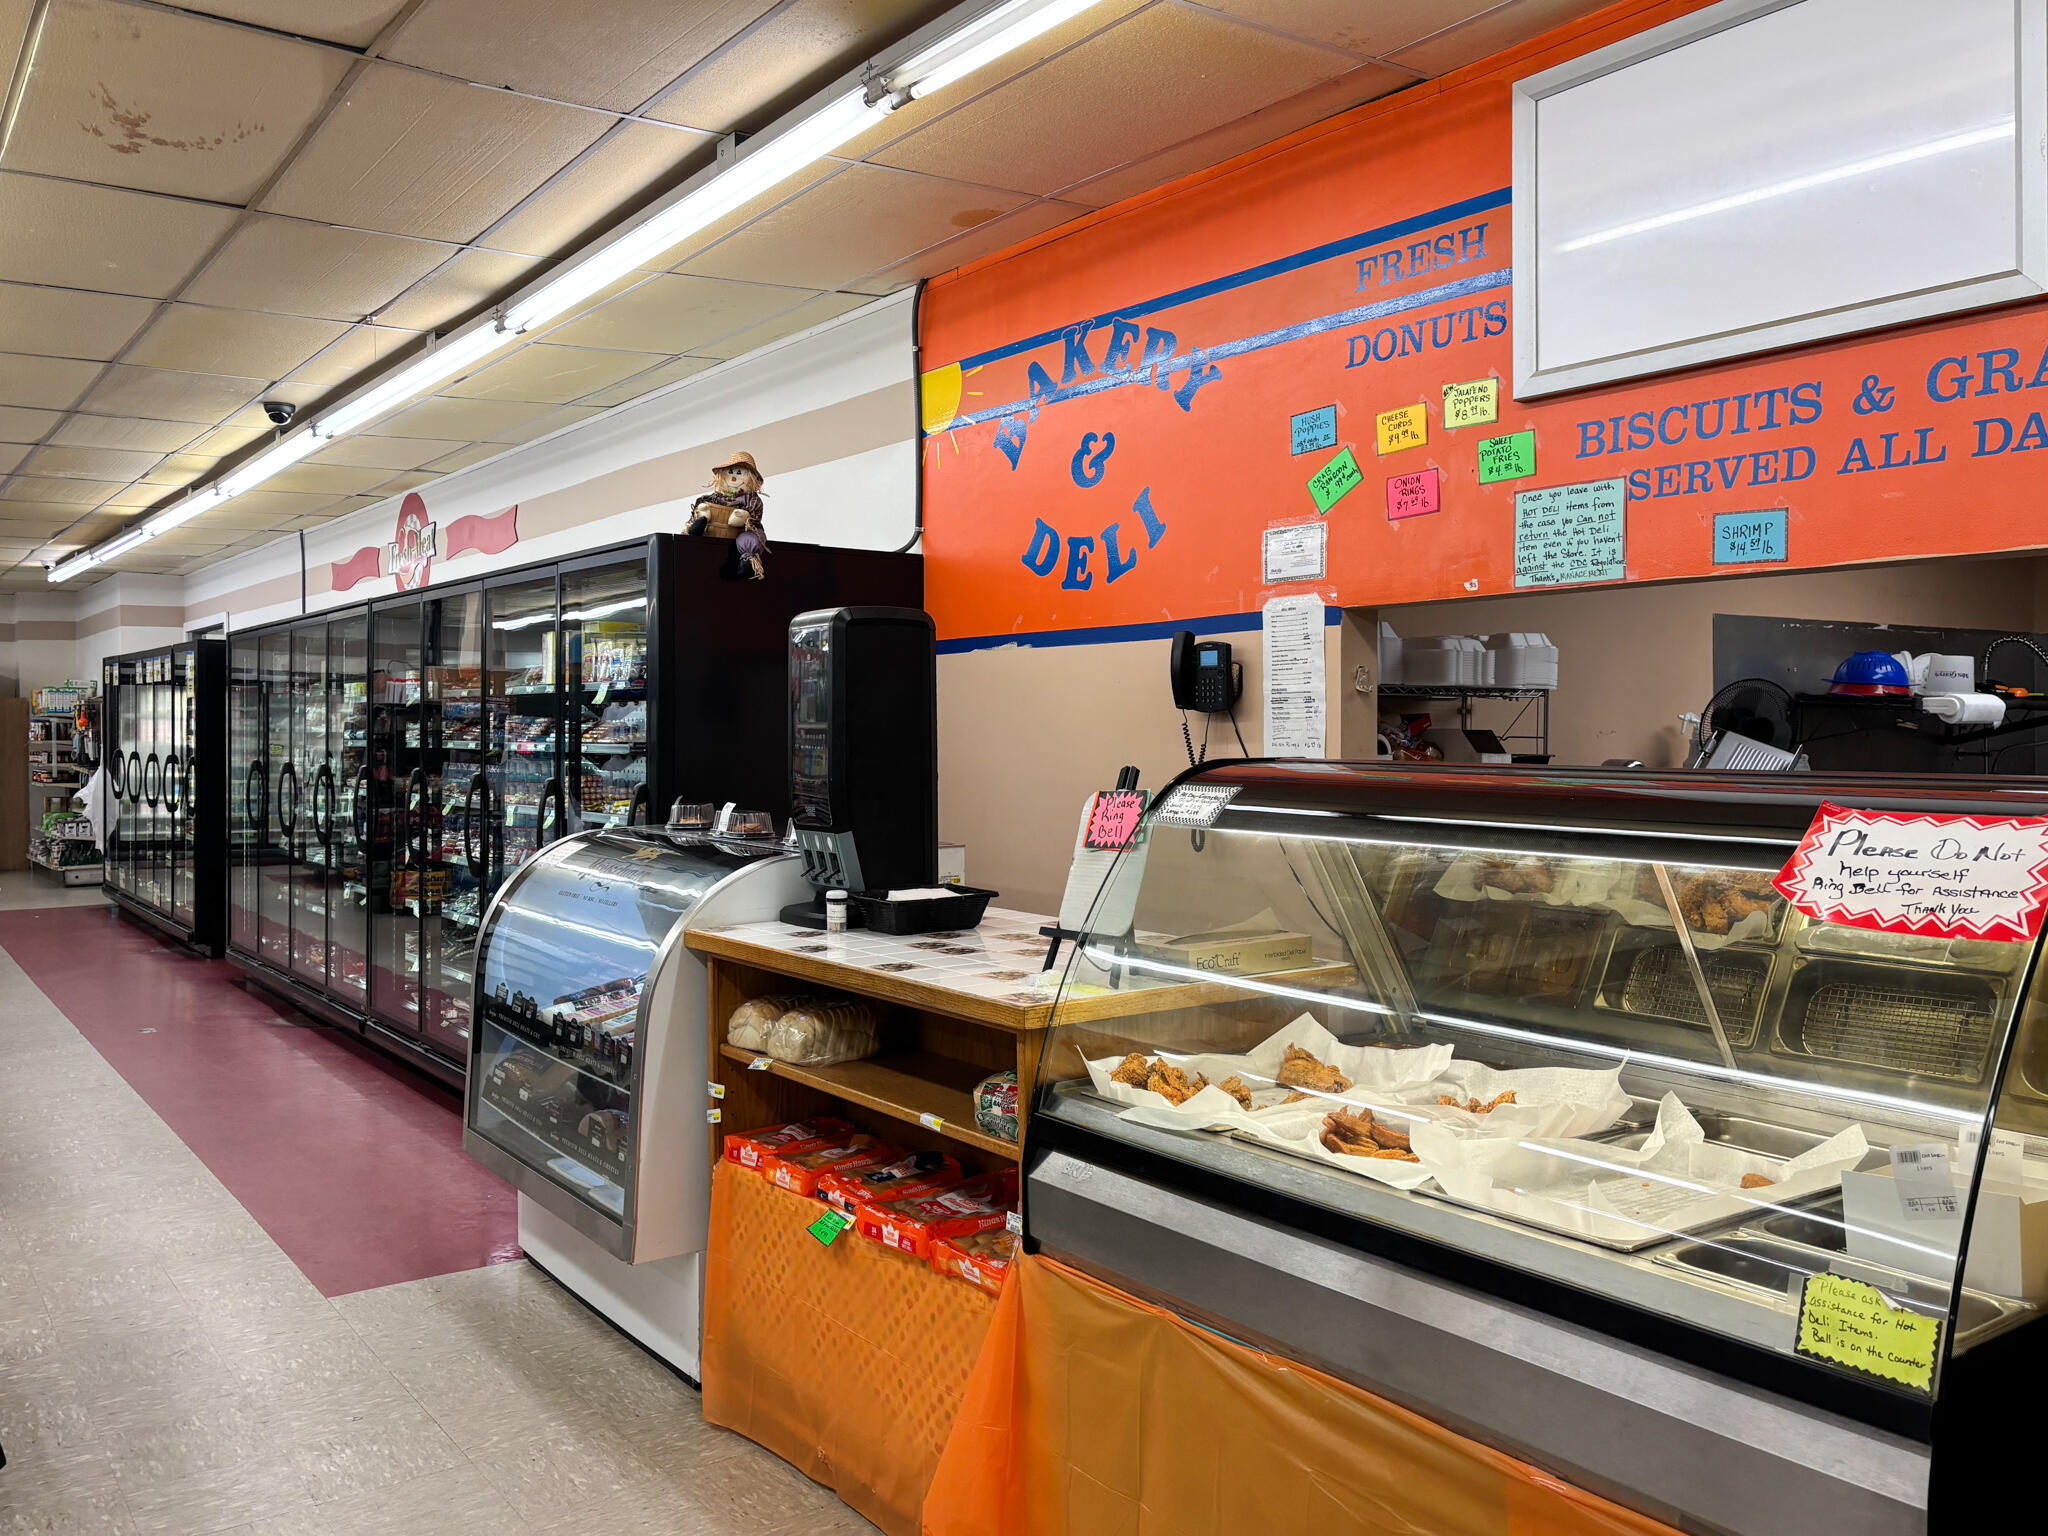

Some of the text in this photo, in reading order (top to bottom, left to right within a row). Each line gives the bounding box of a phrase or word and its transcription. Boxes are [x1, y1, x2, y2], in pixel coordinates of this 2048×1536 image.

[1355, 223, 1488, 292] FRESH
[1345, 300, 1507, 369] DONUTS
[994, 318, 1222, 471] BAKERY
[1453, 394, 1491, 409] POPPERS
[1301, 413, 1321, 427] HUSH
[1381, 410, 1408, 426] CHEESE
[1388, 419, 1412, 432] CURDS
[1576, 382, 1823, 459] BISCUITS
[1853, 375, 1895, 415] &
[1489, 436, 1513, 449] SWEET
[1071, 431, 1115, 488] &
[1480, 445, 1512, 462] POTATO
[1493, 451, 1521, 464] FRIES
[1628, 446, 1816, 501] SERVED
[1838, 428, 1946, 474] ALL
[1313, 467, 1331, 488] CRAB
[1394, 475, 1421, 489] ONION
[1399, 485, 1426, 497] RINGS
[1522, 494, 1542, 504] Once
[1549, 491, 1561, 503] you
[1567, 487, 1588, 496] leave
[1522, 497, 1614, 517] HOT DELI items from
[1519, 521, 1533, 529] the
[1537, 519, 1556, 527] case
[1562, 518, 1573, 529] you
[1598, 510, 1616, 521] not
[1021, 487, 1167, 591] DELI
[1519, 525, 1609, 540] return the Hot Deli
[1722, 522, 1774, 540] SHRIMP
[1519, 542, 1537, 552] item
[1543, 541, 1561, 549] even
[1567, 537, 1573, 547] if
[1577, 539, 1589, 552] you
[1518, 553, 1536, 565] left
[1543, 551, 1557, 560] the
[1592, 547, 1602, 557] It
[1609, 547, 1616, 556] is
[1516, 562, 1546, 575] against
[1552, 560, 1565, 568] the
[1570, 559, 1587, 568] CDC
[1106, 797, 1135, 809] Please
[1101, 808, 1124, 823] Ring
[1098, 825, 1123, 838] Bell
[1930, 838, 1967, 860] Do
[1972, 842, 2026, 861] Not
[1840, 861, 1969, 885] help yourself
[1848, 883, 1891, 895] Bell
[1895, 883, 1924, 895] for
[1946, 904, 1980, 928] You
[1816, 1277, 1856, 1300] Please
[1862, 1295, 1881, 1307] ask
[1809, 1296, 1917, 1332] assistance for Hot
[1808, 1310, 1878, 1339] Deli Items.
[1812, 1327, 1926, 1368] Bell is on the Counter
